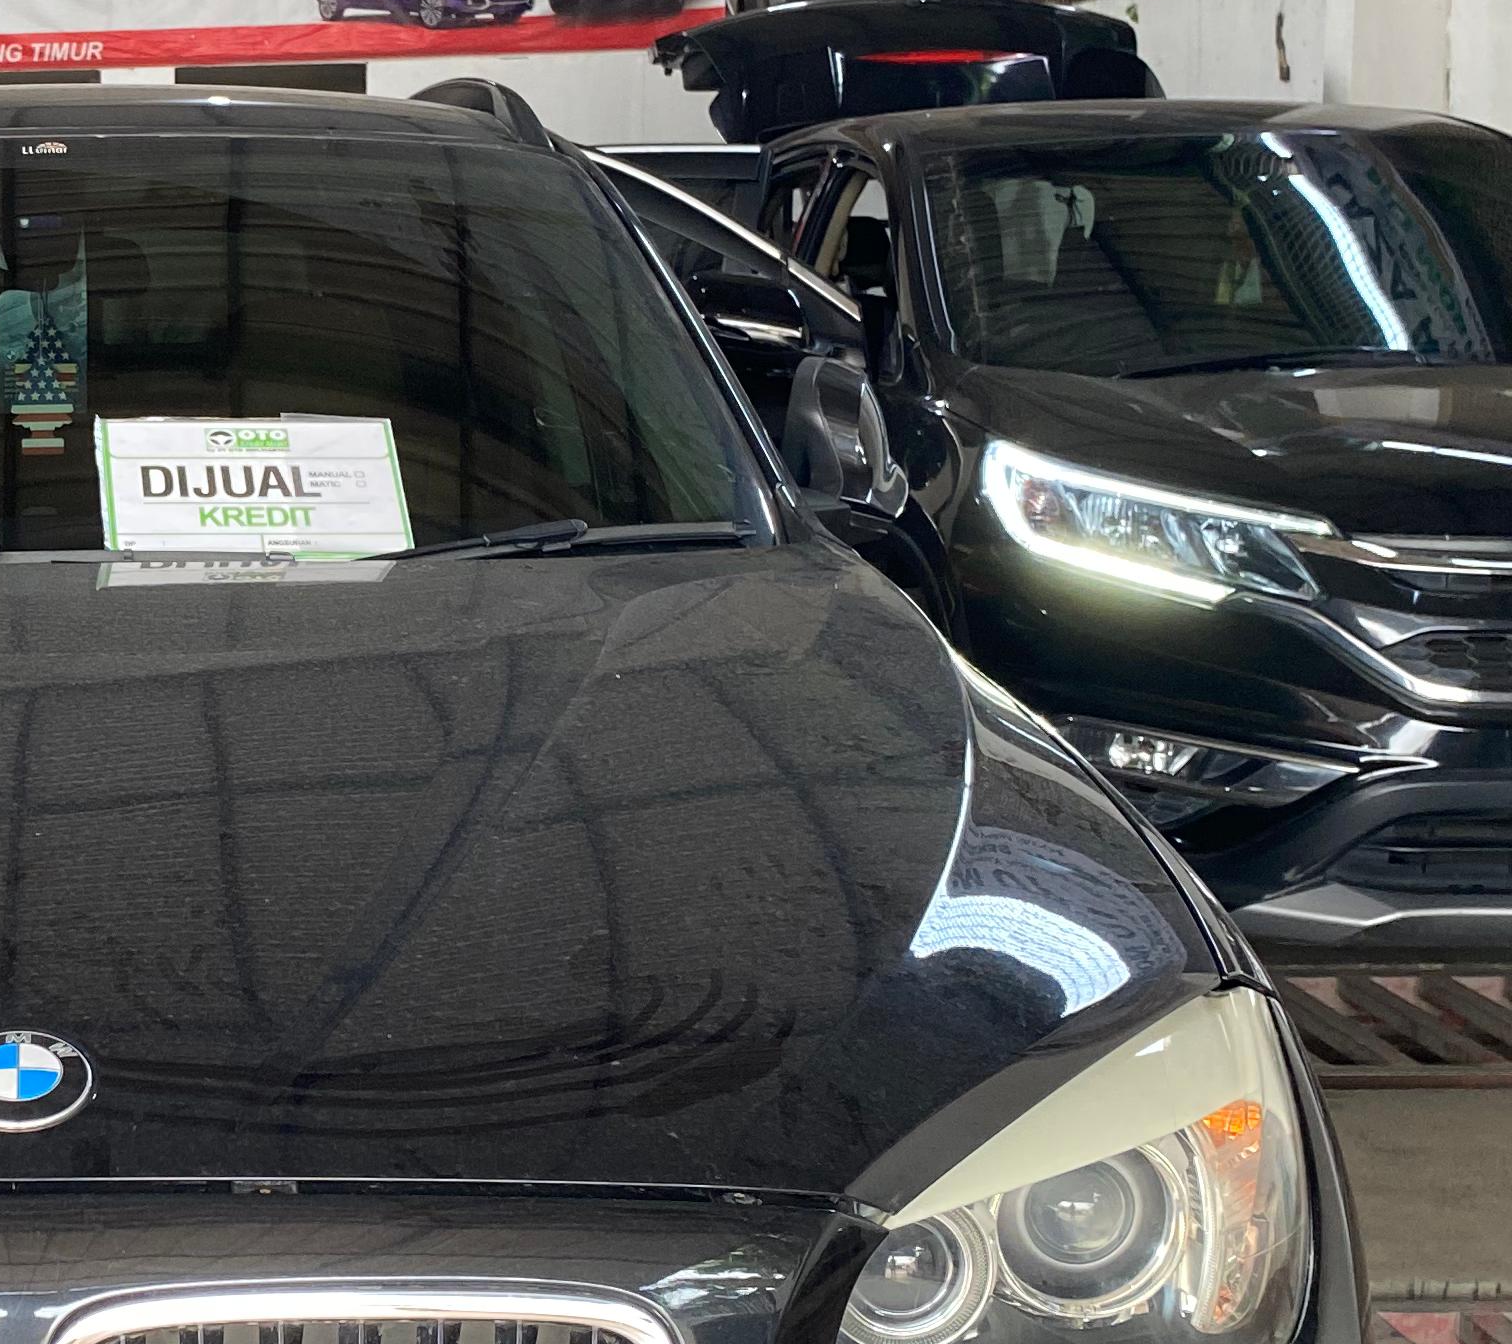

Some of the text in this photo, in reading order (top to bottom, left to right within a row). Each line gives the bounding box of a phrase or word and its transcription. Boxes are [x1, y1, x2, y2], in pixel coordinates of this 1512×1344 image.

[30, 41, 104, 62] TIMUR
[238, 429, 287, 441] OTO
[140, 465, 322, 498] DIJUAL
[199, 506, 316, 527] KREDIT
